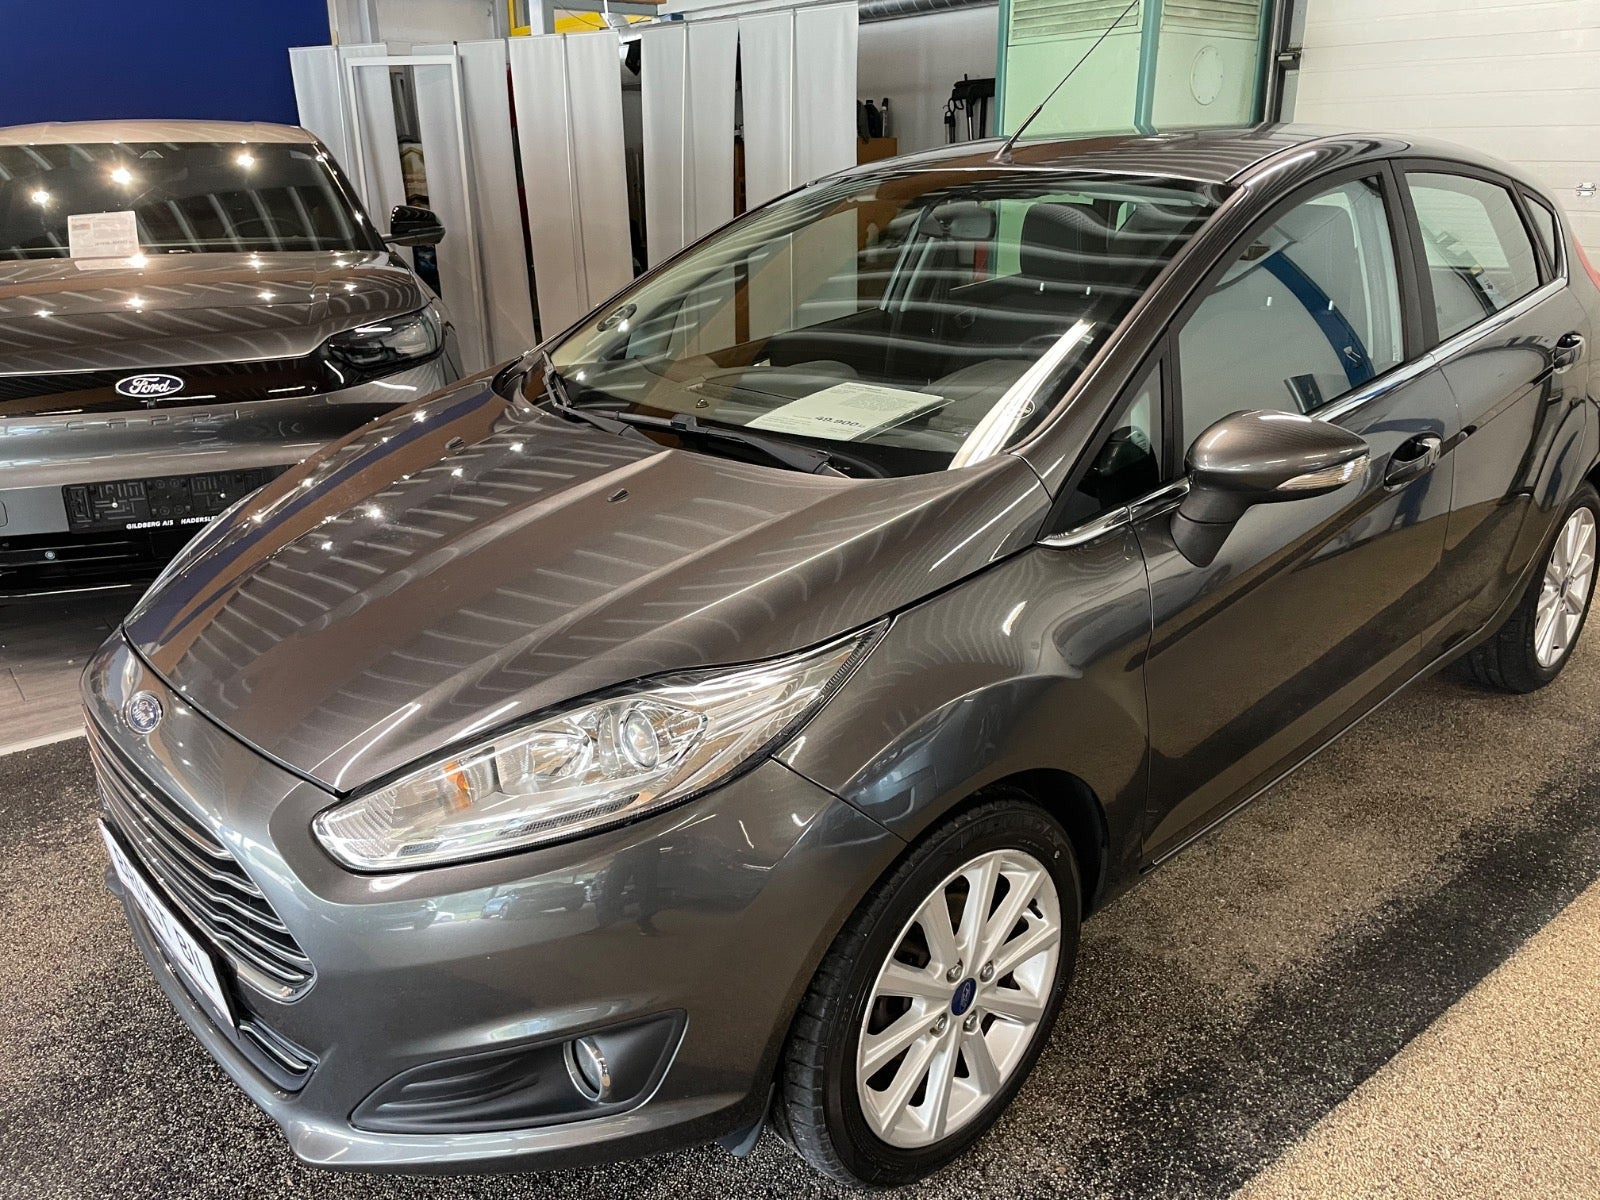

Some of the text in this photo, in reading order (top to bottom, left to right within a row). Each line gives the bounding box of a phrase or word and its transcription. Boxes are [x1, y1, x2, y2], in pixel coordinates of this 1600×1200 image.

[129, 377, 173, 394] Ford
[126, 521, 160, 530] GILDBERG
[181, 515, 218, 525] HADERSLE
[173, 926, 215, 991] BIL
